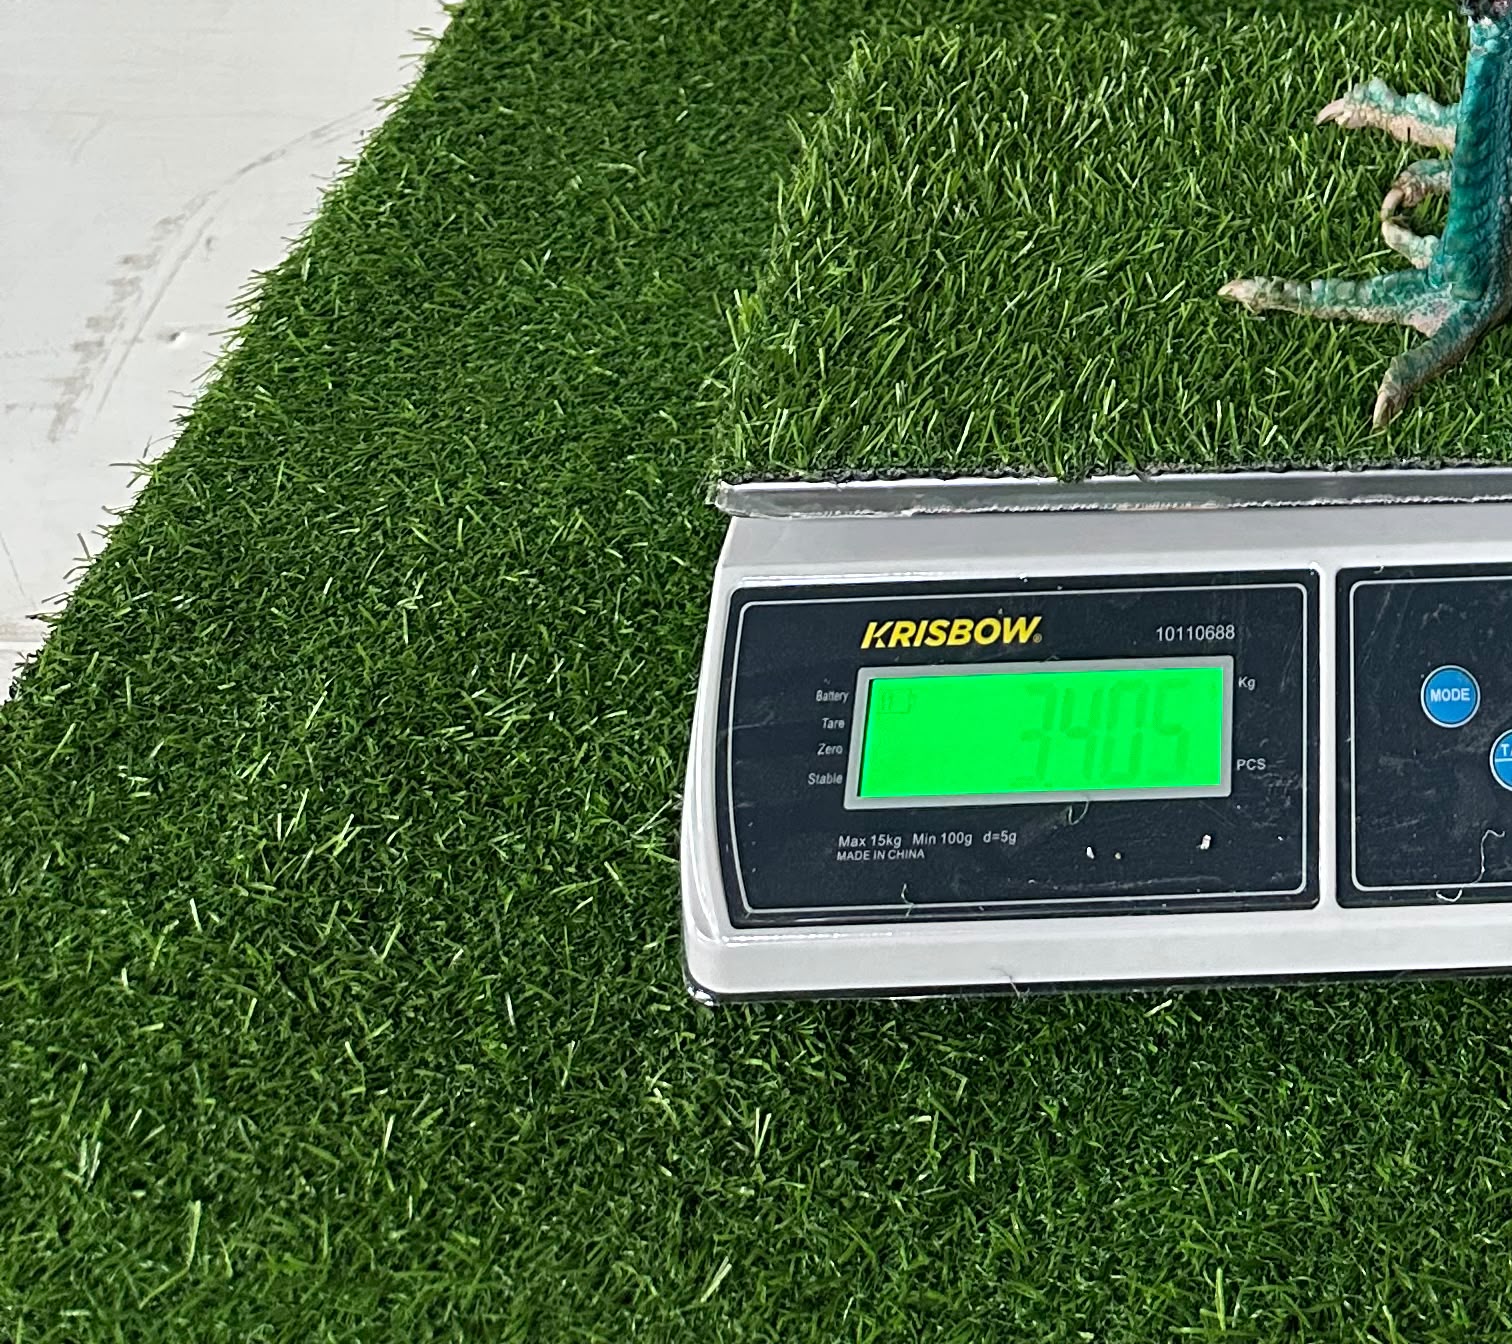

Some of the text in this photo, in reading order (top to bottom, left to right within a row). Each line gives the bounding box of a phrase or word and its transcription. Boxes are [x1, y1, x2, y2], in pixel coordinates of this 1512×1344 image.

[861, 616, 1042, 650] KRISBOW
[1155, 624, 1236, 643] 10110688
[1238, 676, 1256, 690] Kg
[815, 689, 849, 704] Battery
[1430, 687, 1471, 703] MODE
[822, 717, 845, 729] Tare
[817, 742, 844, 756] Zero
[1236, 757, 1266, 771] PCS
[807, 772, 843, 785] Stable
[838, 829, 1017, 849] Max 15kg Min 100g d=5g
[836, 848, 925, 861] MADE IN CHINA
